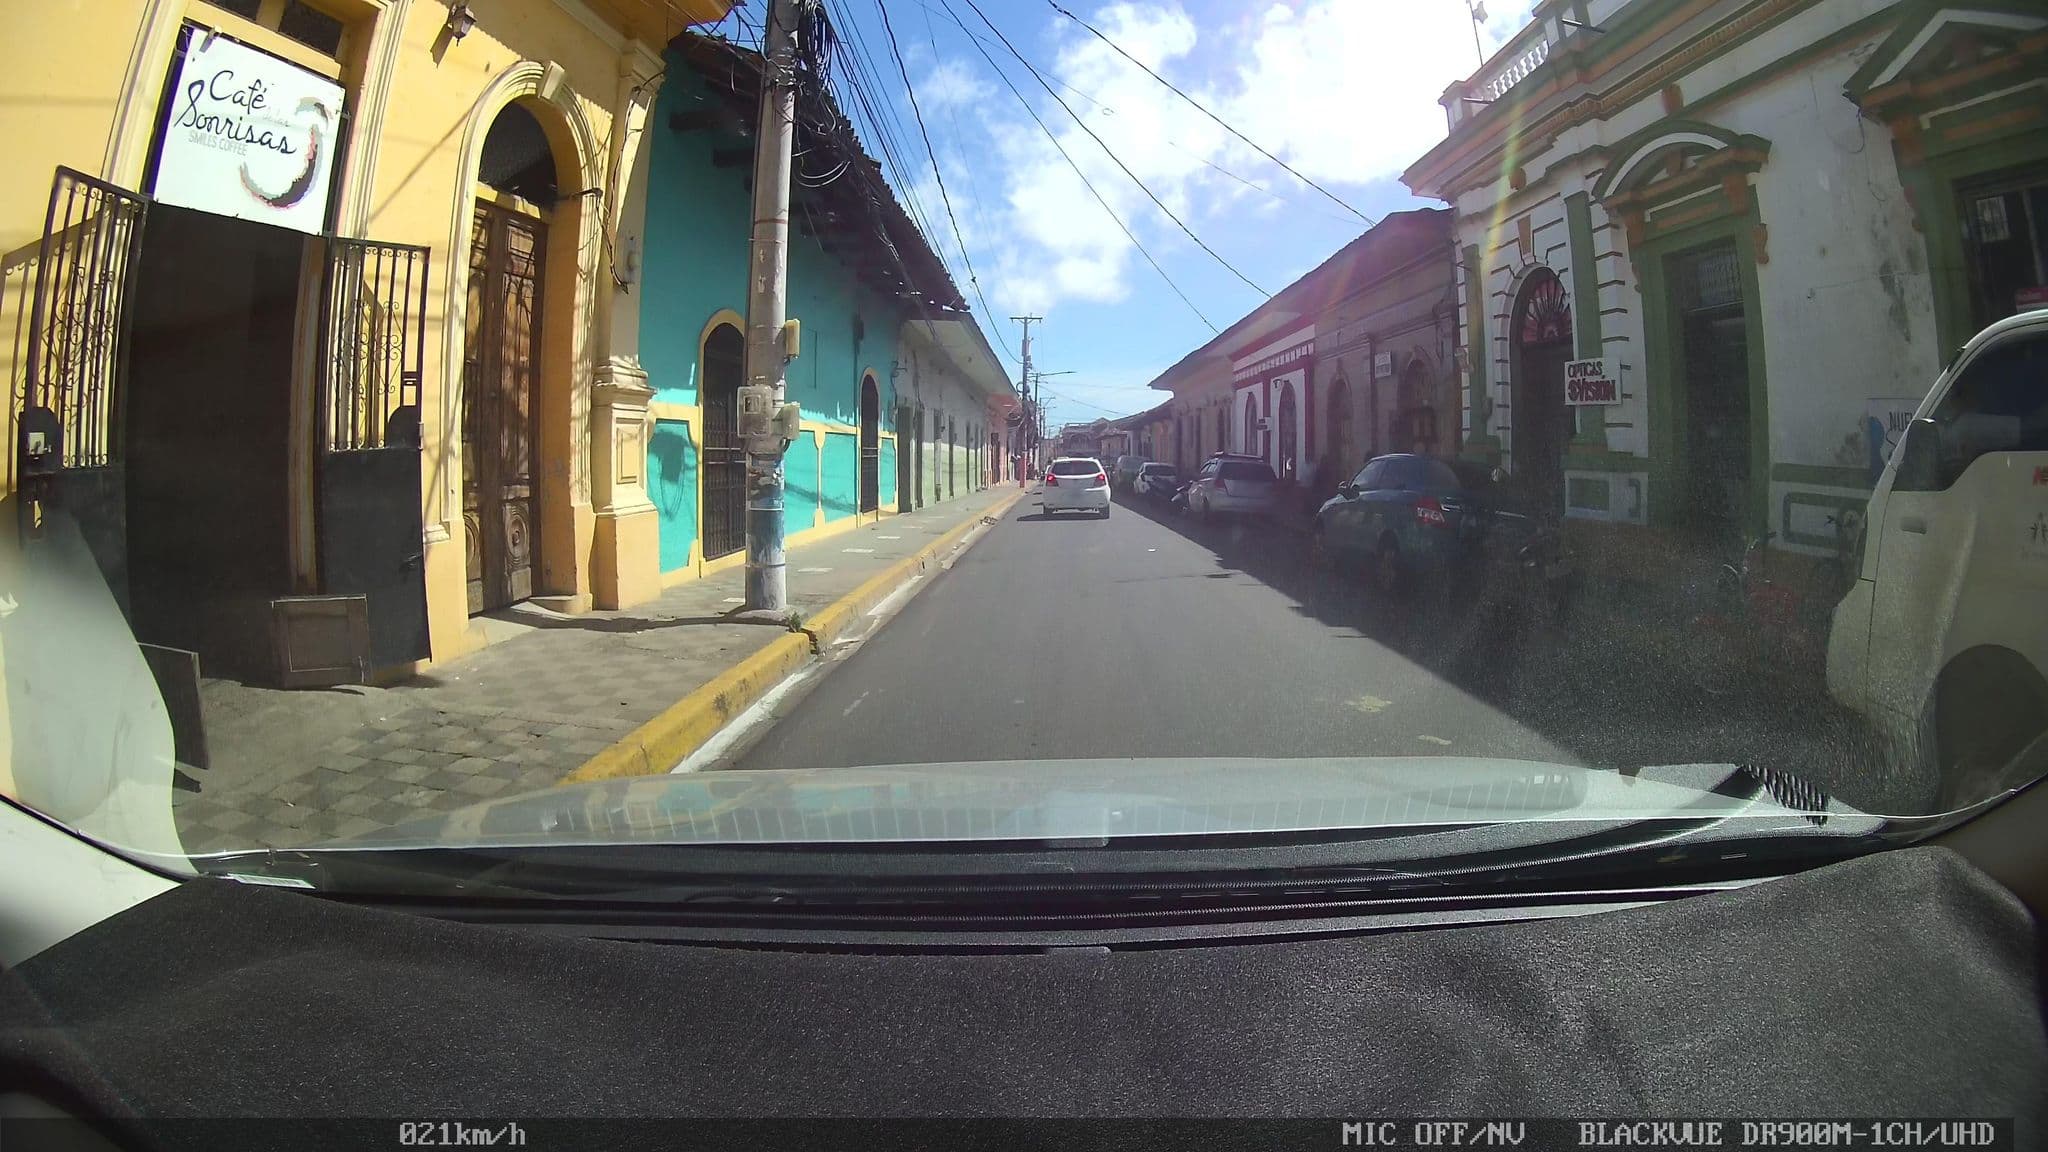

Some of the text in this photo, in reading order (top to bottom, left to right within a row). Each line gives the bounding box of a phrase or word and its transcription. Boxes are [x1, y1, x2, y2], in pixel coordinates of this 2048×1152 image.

[209, 70, 267, 114] Café
[173, 79, 297, 154] Sonrisas
[189, 130, 248, 157] SMILES COFFEE
